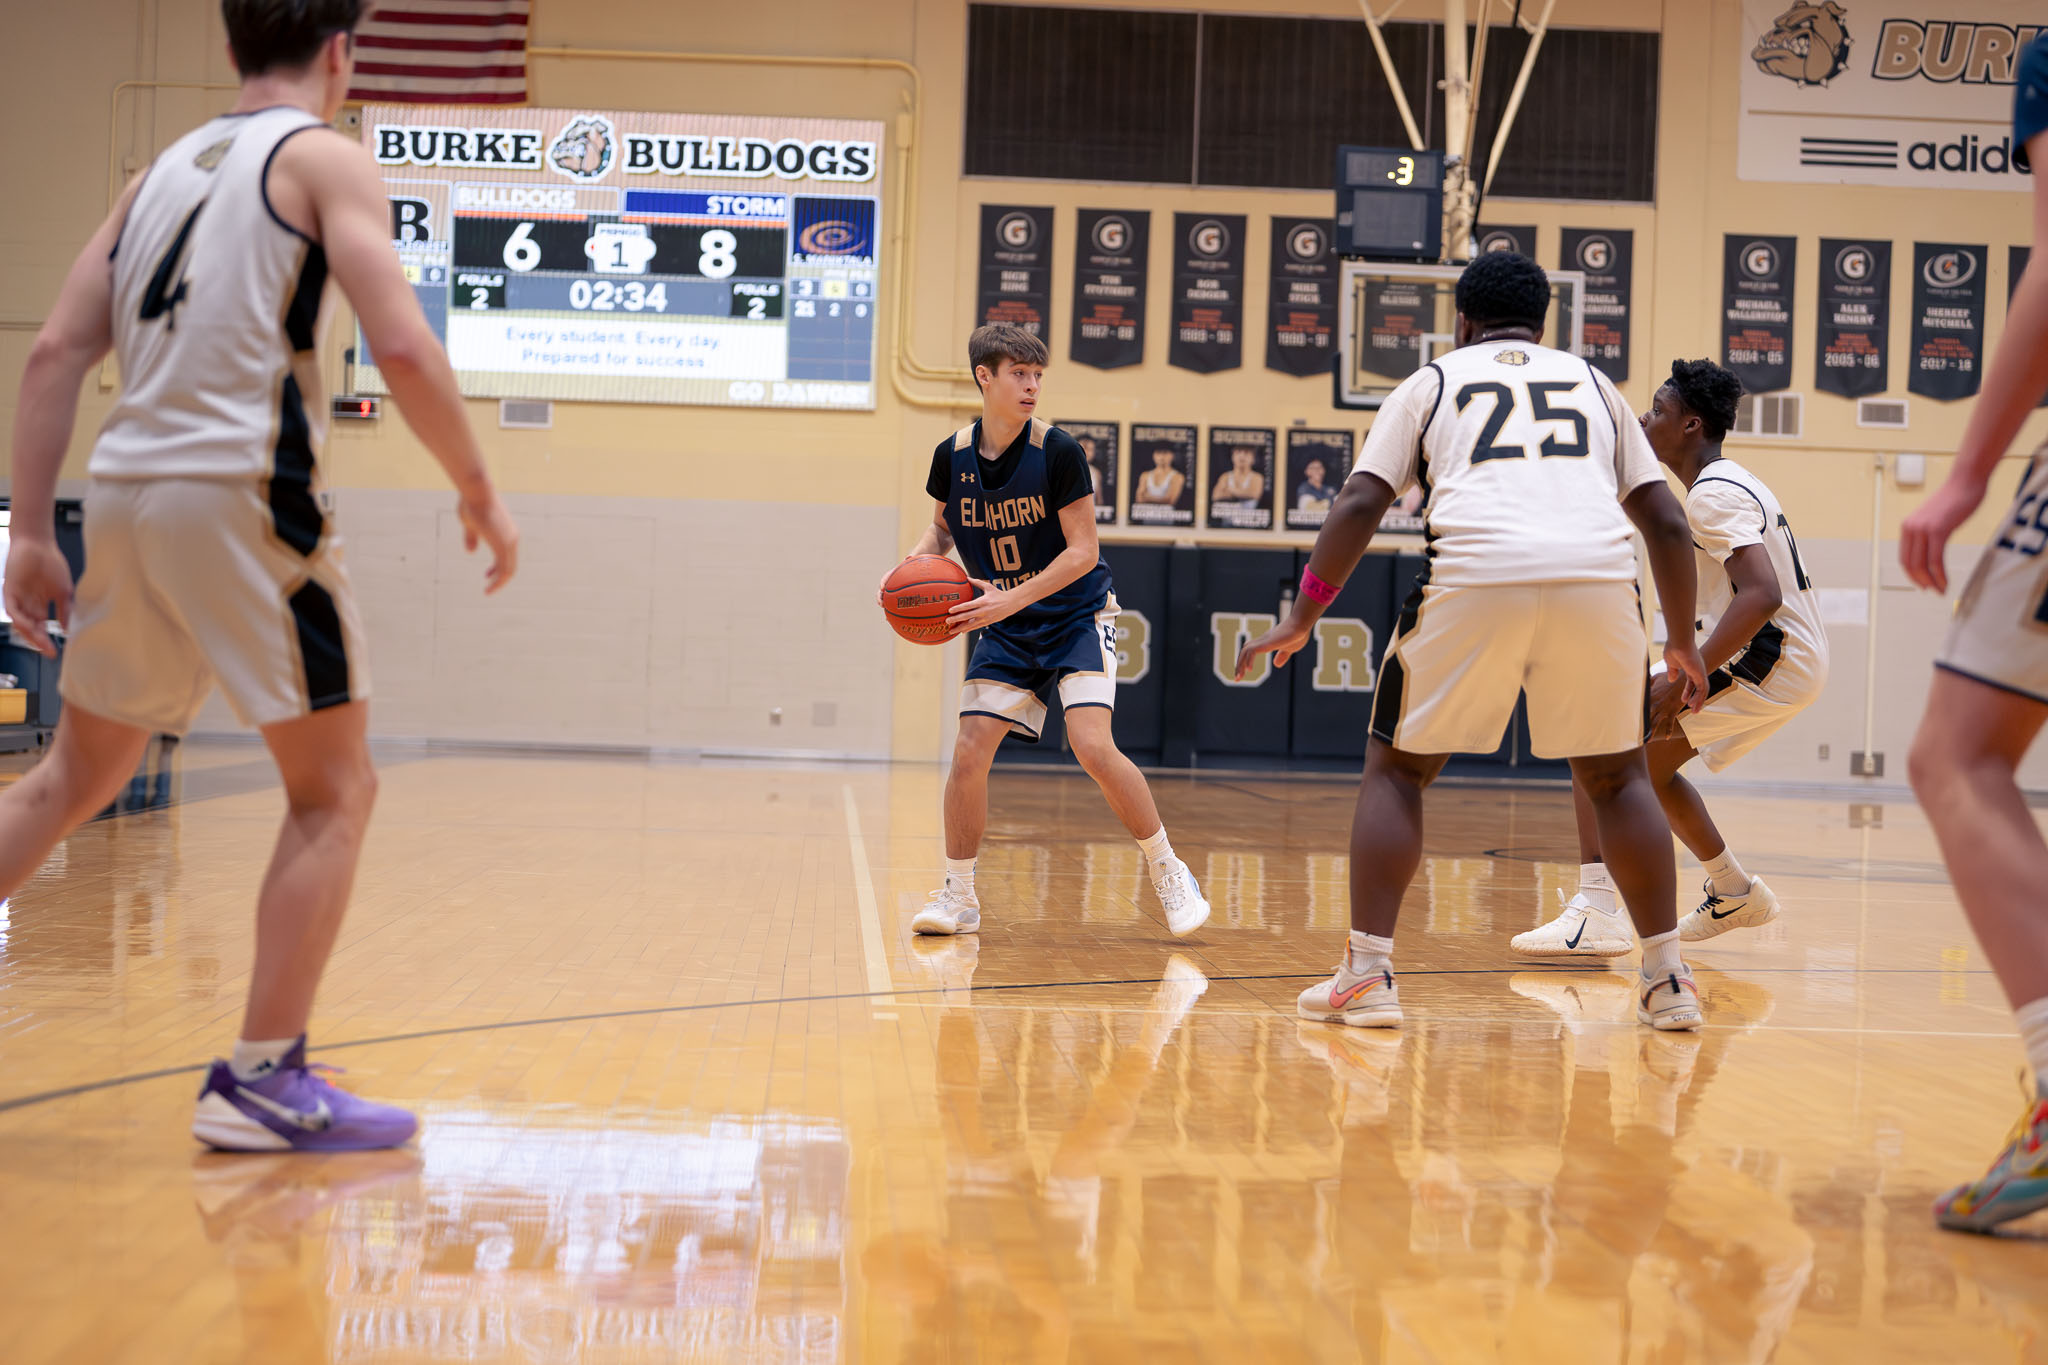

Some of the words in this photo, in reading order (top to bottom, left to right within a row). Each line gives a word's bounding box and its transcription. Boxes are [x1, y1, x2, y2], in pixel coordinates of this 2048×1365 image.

[378, 129, 536, 164] BURKE
[627, 138, 870, 176] BULLDOGS
[1387, 157, 1415, 186] .3
[458, 187, 576, 209] BULLDOGS
[706, 195, 785, 216] STORM
[503, 222, 542, 272] 6
[610, 241, 629, 268] 1
[698, 229, 738, 280] 8
[139, 197, 191, 332] 4
[457, 273, 504, 287] FOULS
[732, 283, 780, 296] FOULS
[470, 287, 489, 310] 2
[569, 279, 668, 313] 02:34
[747, 297, 767, 320] 2
[506, 326, 554, 344] Every
[636, 330, 683, 348] Every
[522, 350, 599, 366] Prepared
[606, 351, 628, 365] for
[1728, 349, 1760, 364] 2004
[1825, 352, 1856, 367] 2005
[1920, 357, 1947, 371] 2017
[728, 381, 765, 401] GO
[1454, 381, 1590, 465] 25
[989, 535, 1022, 571] 10
[1313, 618, 1376, 692] R
